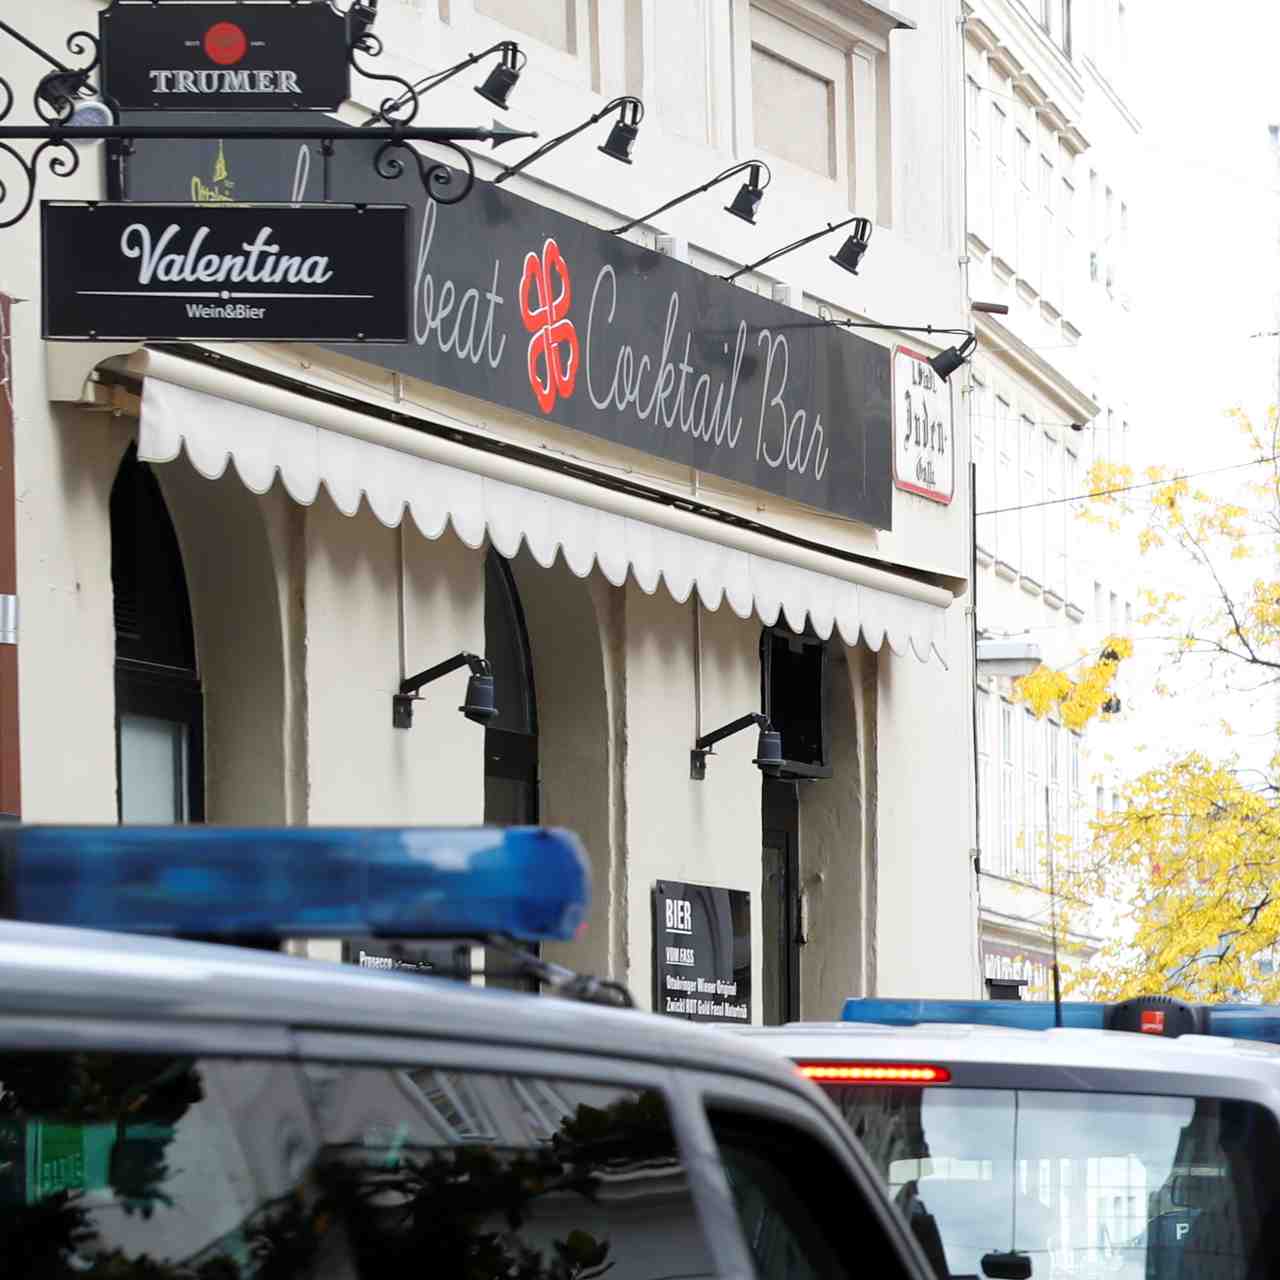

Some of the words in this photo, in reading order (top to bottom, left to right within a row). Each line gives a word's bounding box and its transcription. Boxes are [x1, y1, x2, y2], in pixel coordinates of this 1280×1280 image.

[150, 70, 303, 93] TRUMER
[120, 223, 333, 285] Valentina
[185, 304, 266, 319] Wein&Bier
[586, 265, 746, 449] Cocktail
[756, 328, 829, 480] Bar
[665, 899, 692, 930] BIER
